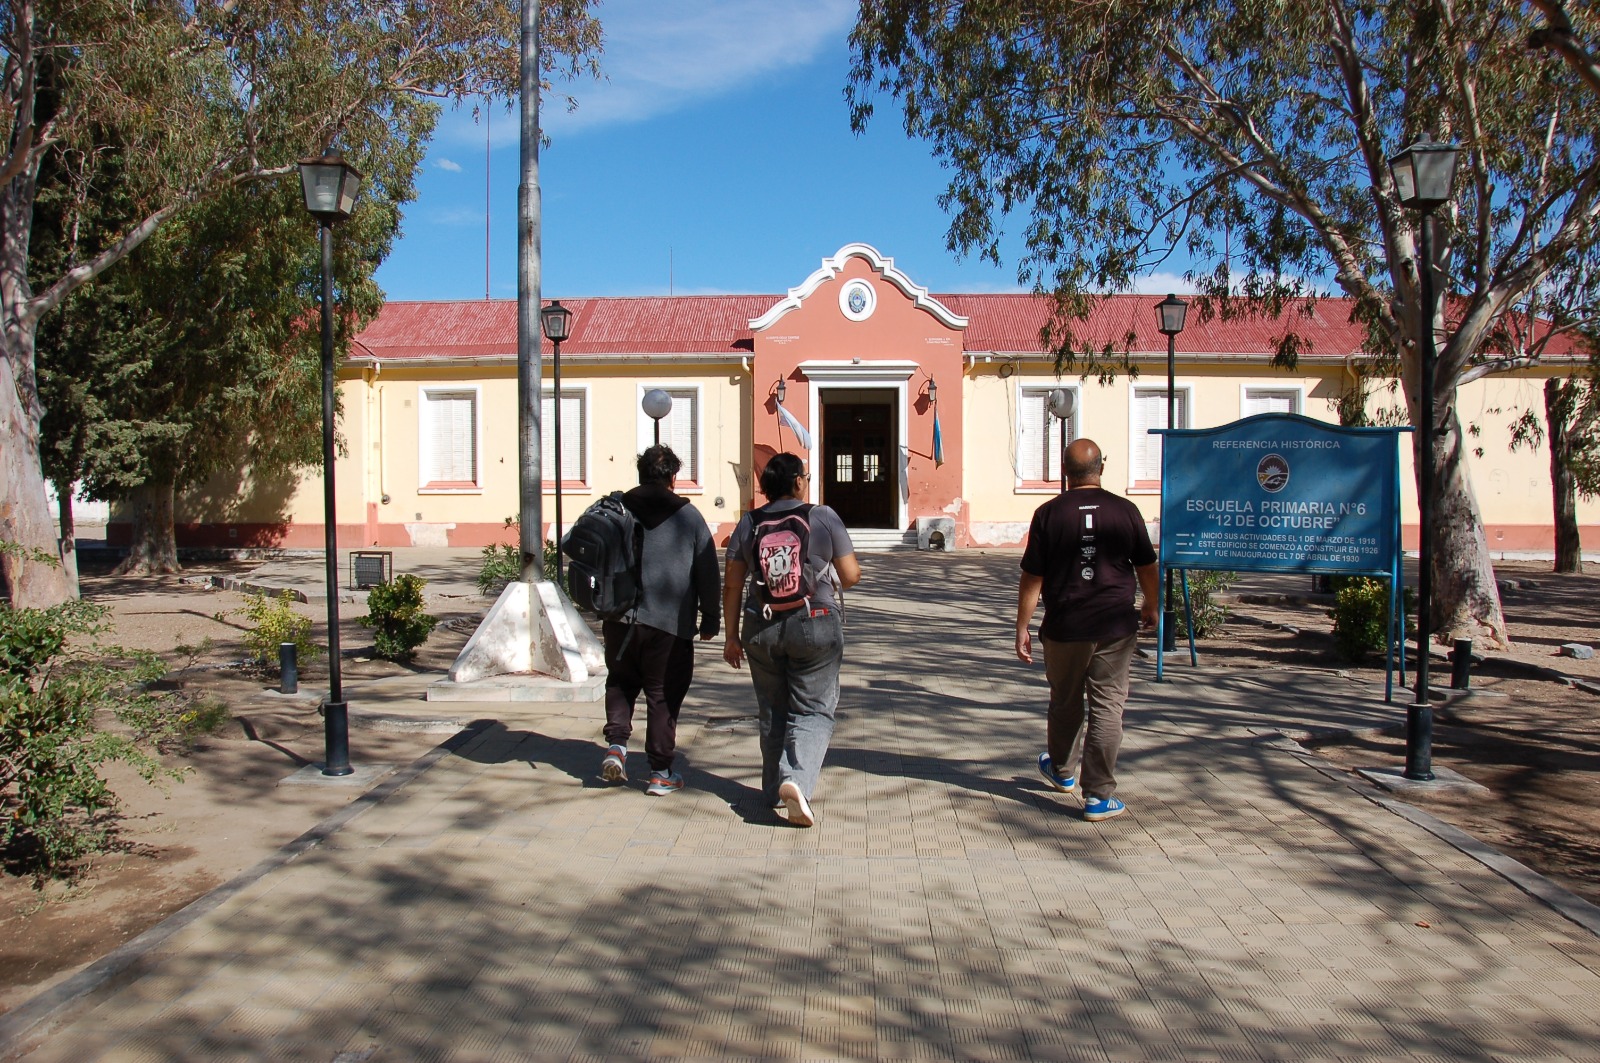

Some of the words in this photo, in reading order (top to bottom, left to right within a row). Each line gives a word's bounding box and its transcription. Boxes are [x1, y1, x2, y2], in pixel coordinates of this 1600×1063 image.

[1212, 440, 1278, 449] REFERENCIA
[1281, 439, 1341, 449] HISTÓRICA
[1186, 500, 1254, 512] ESCUELA
[1261, 501, 1335, 515] PRIMARIA
[1235, 515, 1255, 527] DE
[1224, 533, 1239, 541] SUS
[1240, 534, 1287, 542] ACTIVIDADES
[1304, 535, 1315, 543] DE
[1316, 536, 1343, 544] MARZO
[1359, 537, 1376, 545] 1918
[1217, 541, 1247, 549] EDIFICIO
[1260, 543, 1296, 551] COMENZÓ
[1304, 545, 1347, 553] CONSTRUIR
[1230, 551, 1277, 559] INAUGURADO
[1279, 552, 1288, 560] EL
[1307, 553, 1328, 561] ABRIL
[1330, 554, 1341, 562] DE
[1342, 555, 1360, 563] 1930
